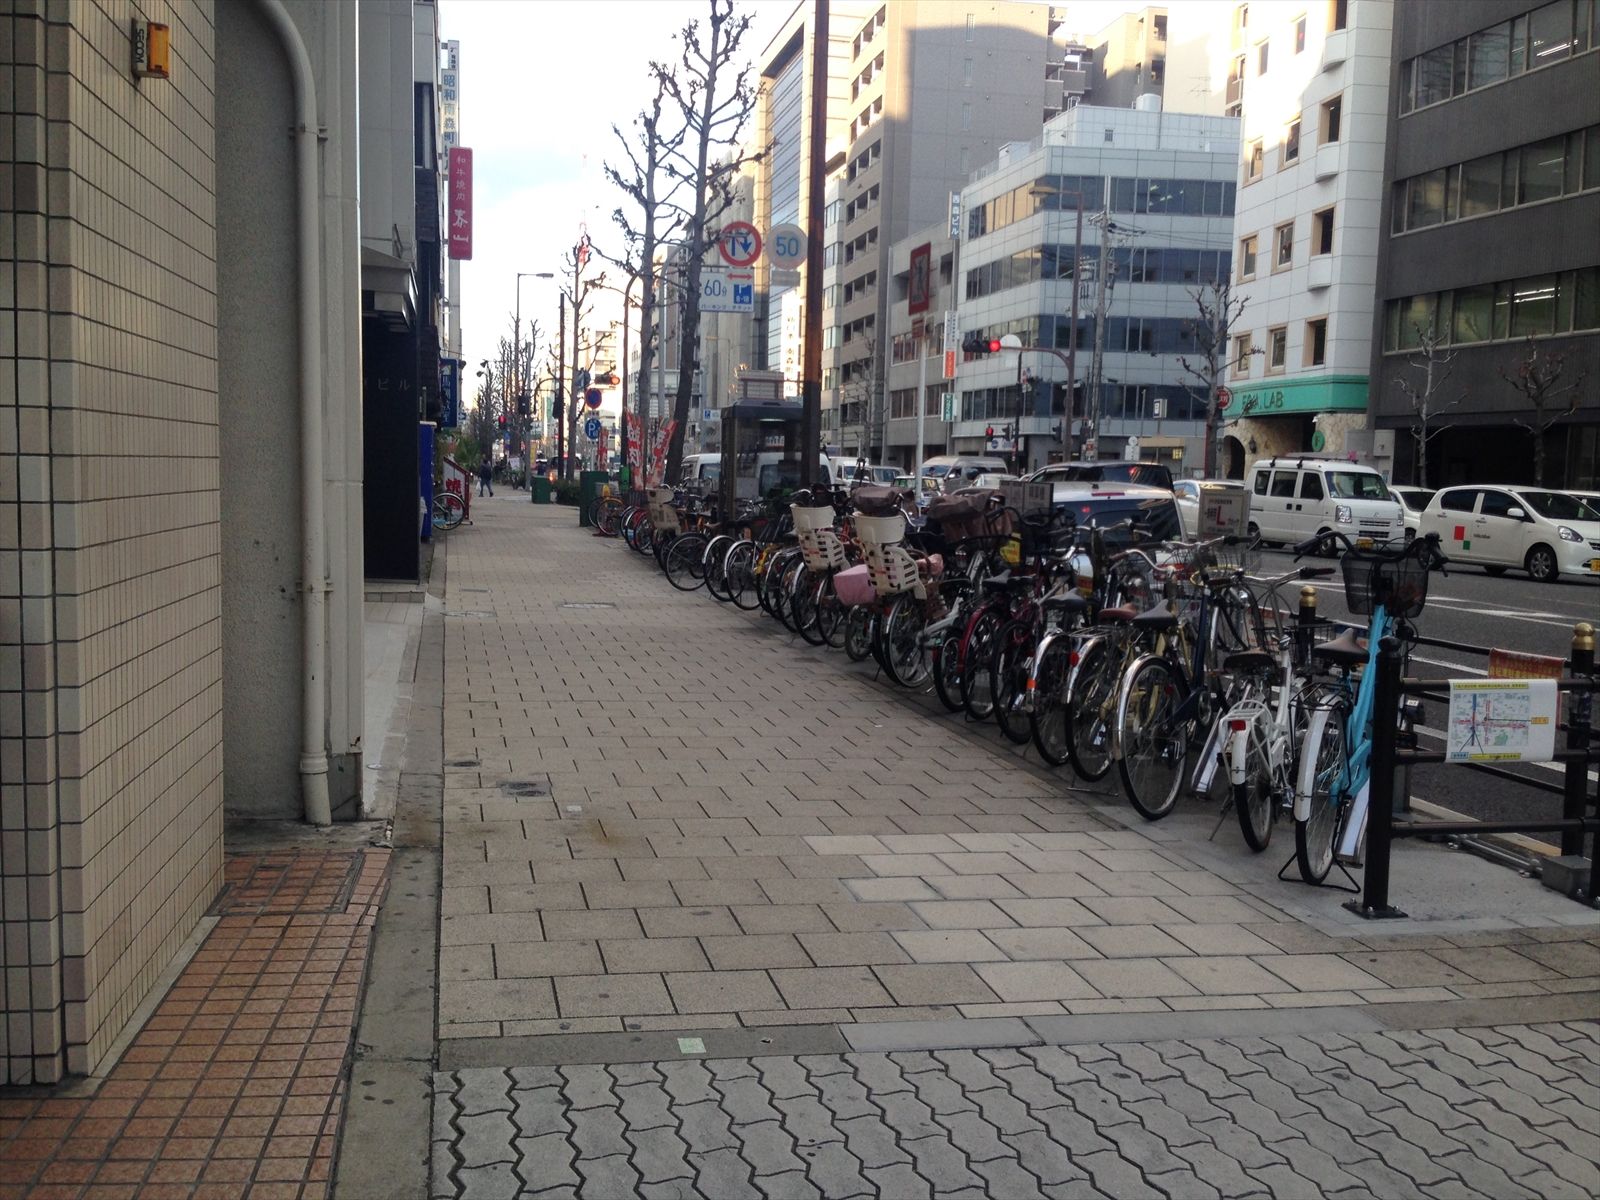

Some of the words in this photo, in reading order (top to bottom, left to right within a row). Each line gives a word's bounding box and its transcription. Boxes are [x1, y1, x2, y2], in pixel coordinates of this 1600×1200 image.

[136, 28, 144, 63] SECOM
[443, 74, 456, 171] 昭和南森町
[776, 236, 799, 256] 50
[1263, 391, 1284, 409] LAB
